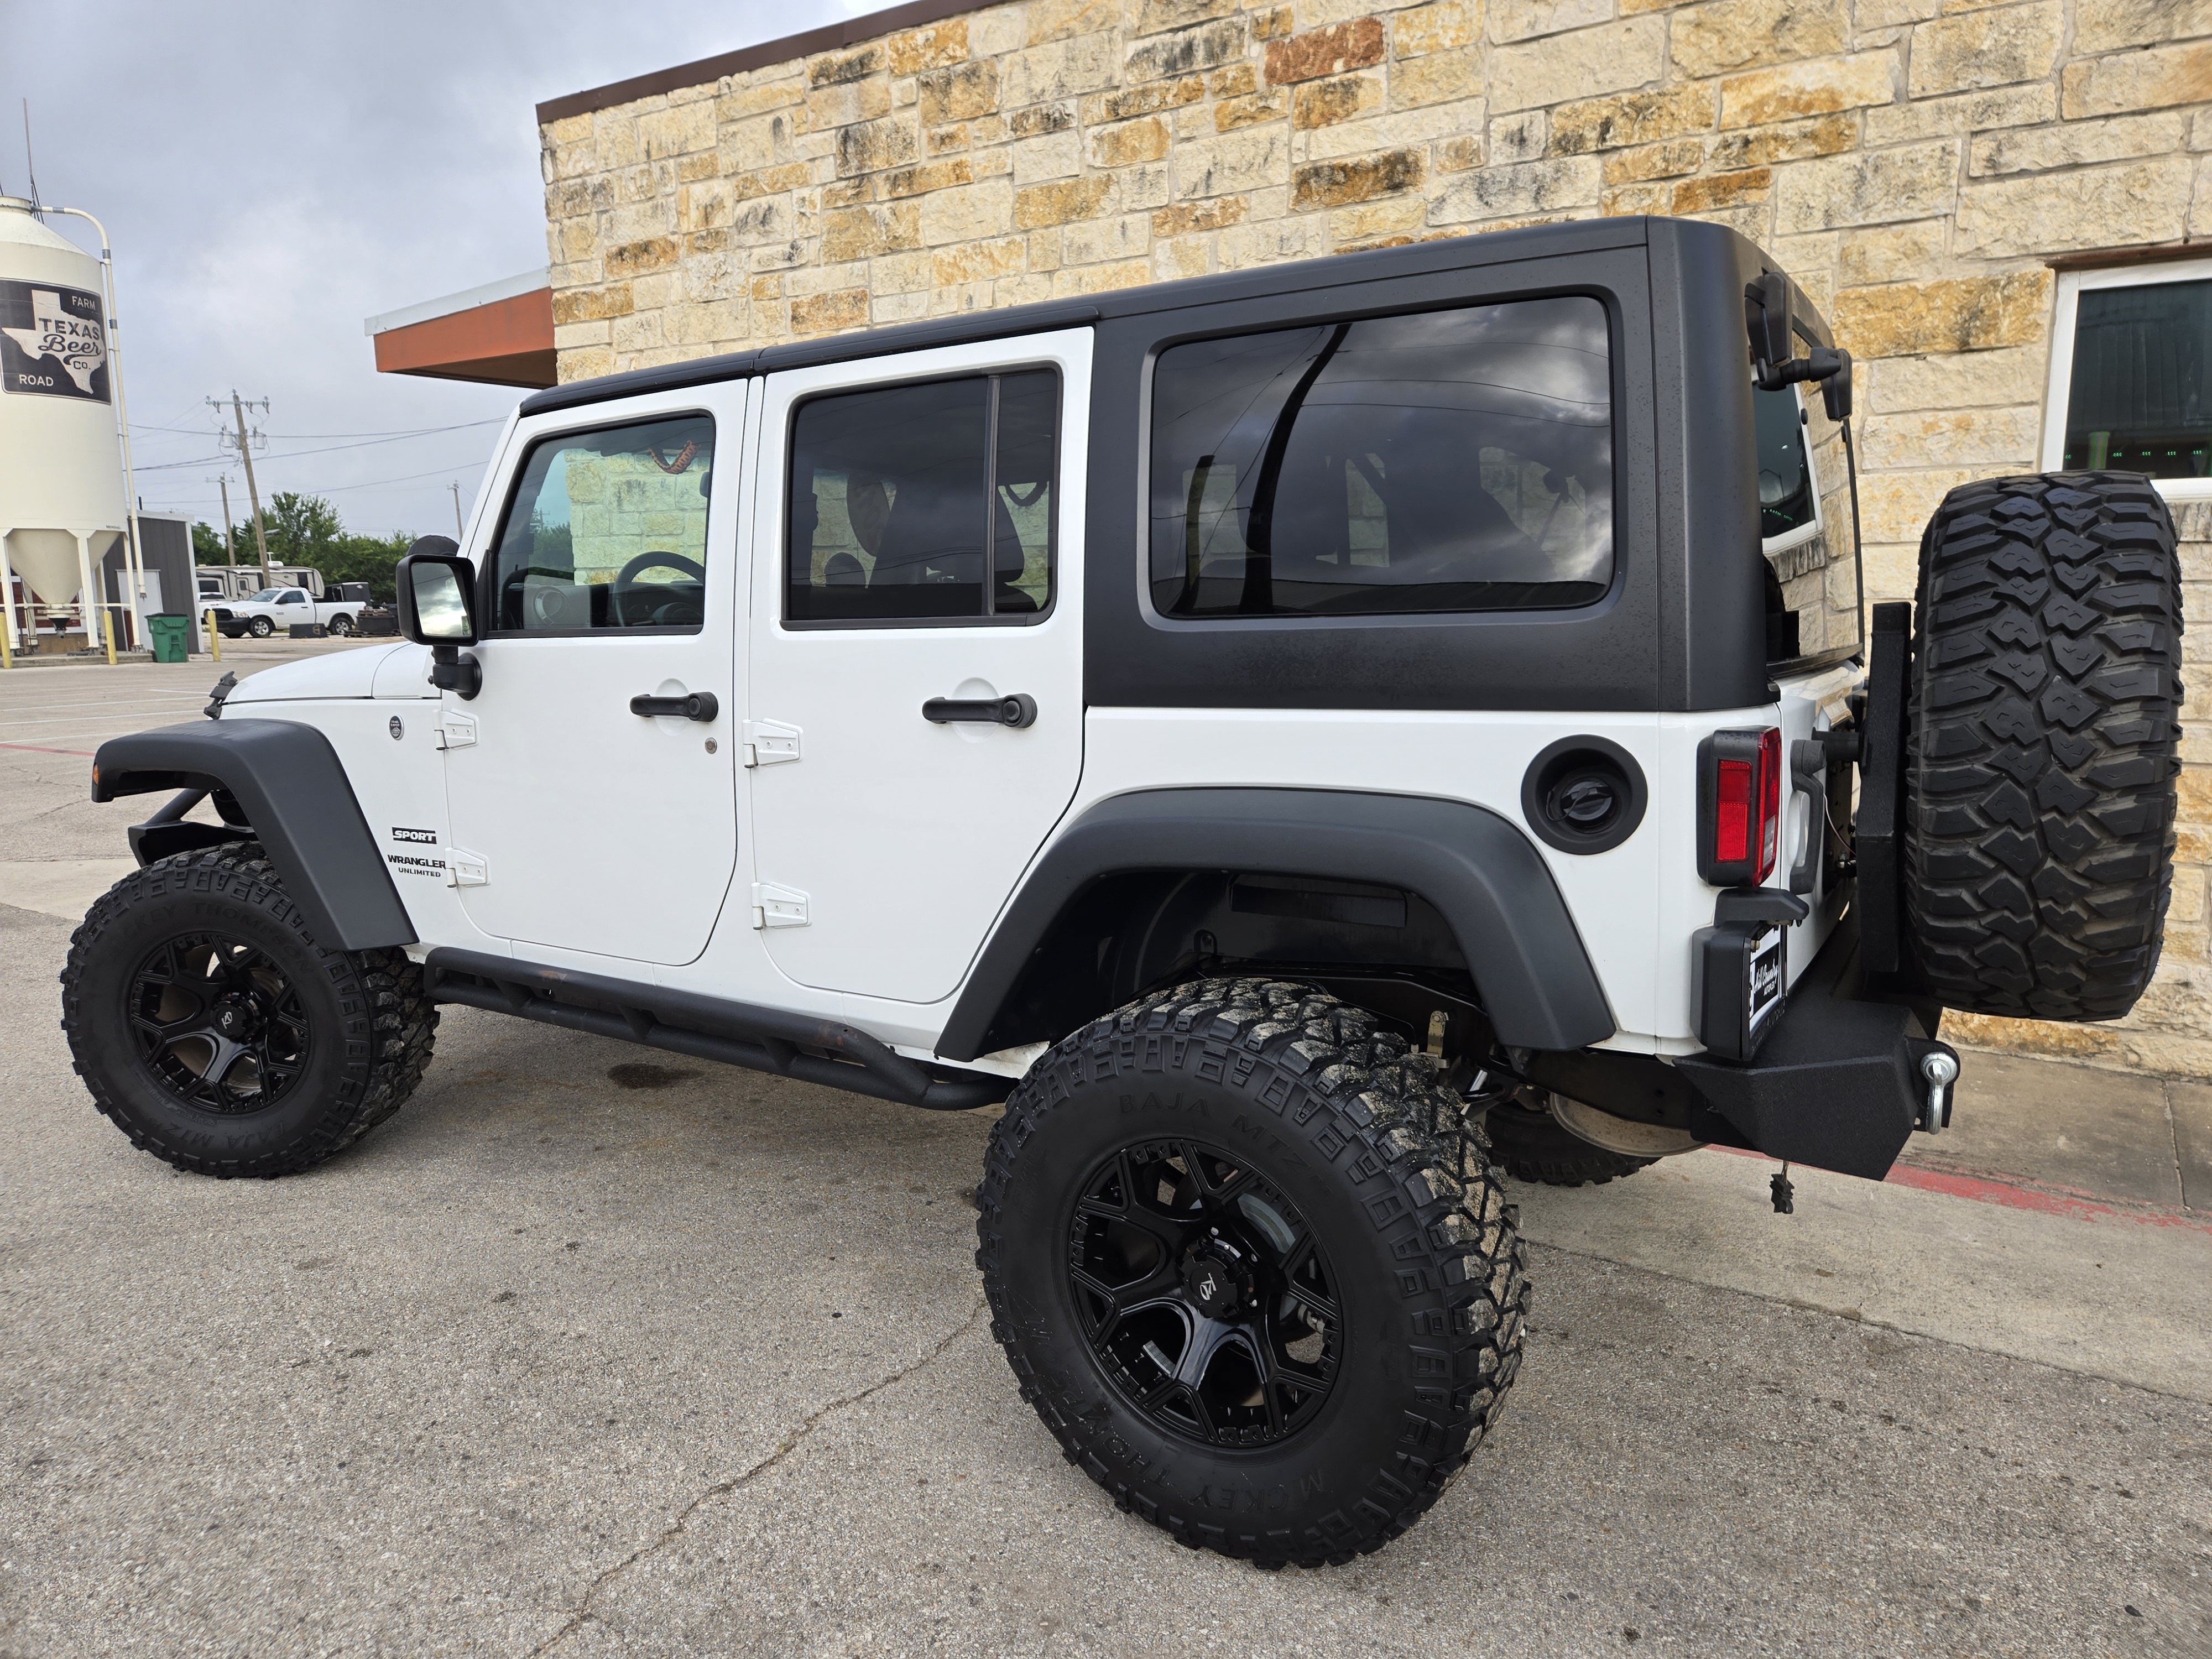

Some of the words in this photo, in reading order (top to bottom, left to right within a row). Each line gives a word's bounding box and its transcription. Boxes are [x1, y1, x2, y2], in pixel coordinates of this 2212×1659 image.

[71, 295, 96, 311] FARM
[39, 317, 100, 341] TEXAS
[38, 333, 102, 356] Beer
[73, 361, 91, 370] CO.
[19, 374, 54, 387] ROAD
[394, 830, 436, 842] SPORT
[387, 854, 446, 870] WRANGLER
[398, 867, 441, 877] UNLIMITED
[1118, 1091, 1209, 1119] BAJA
